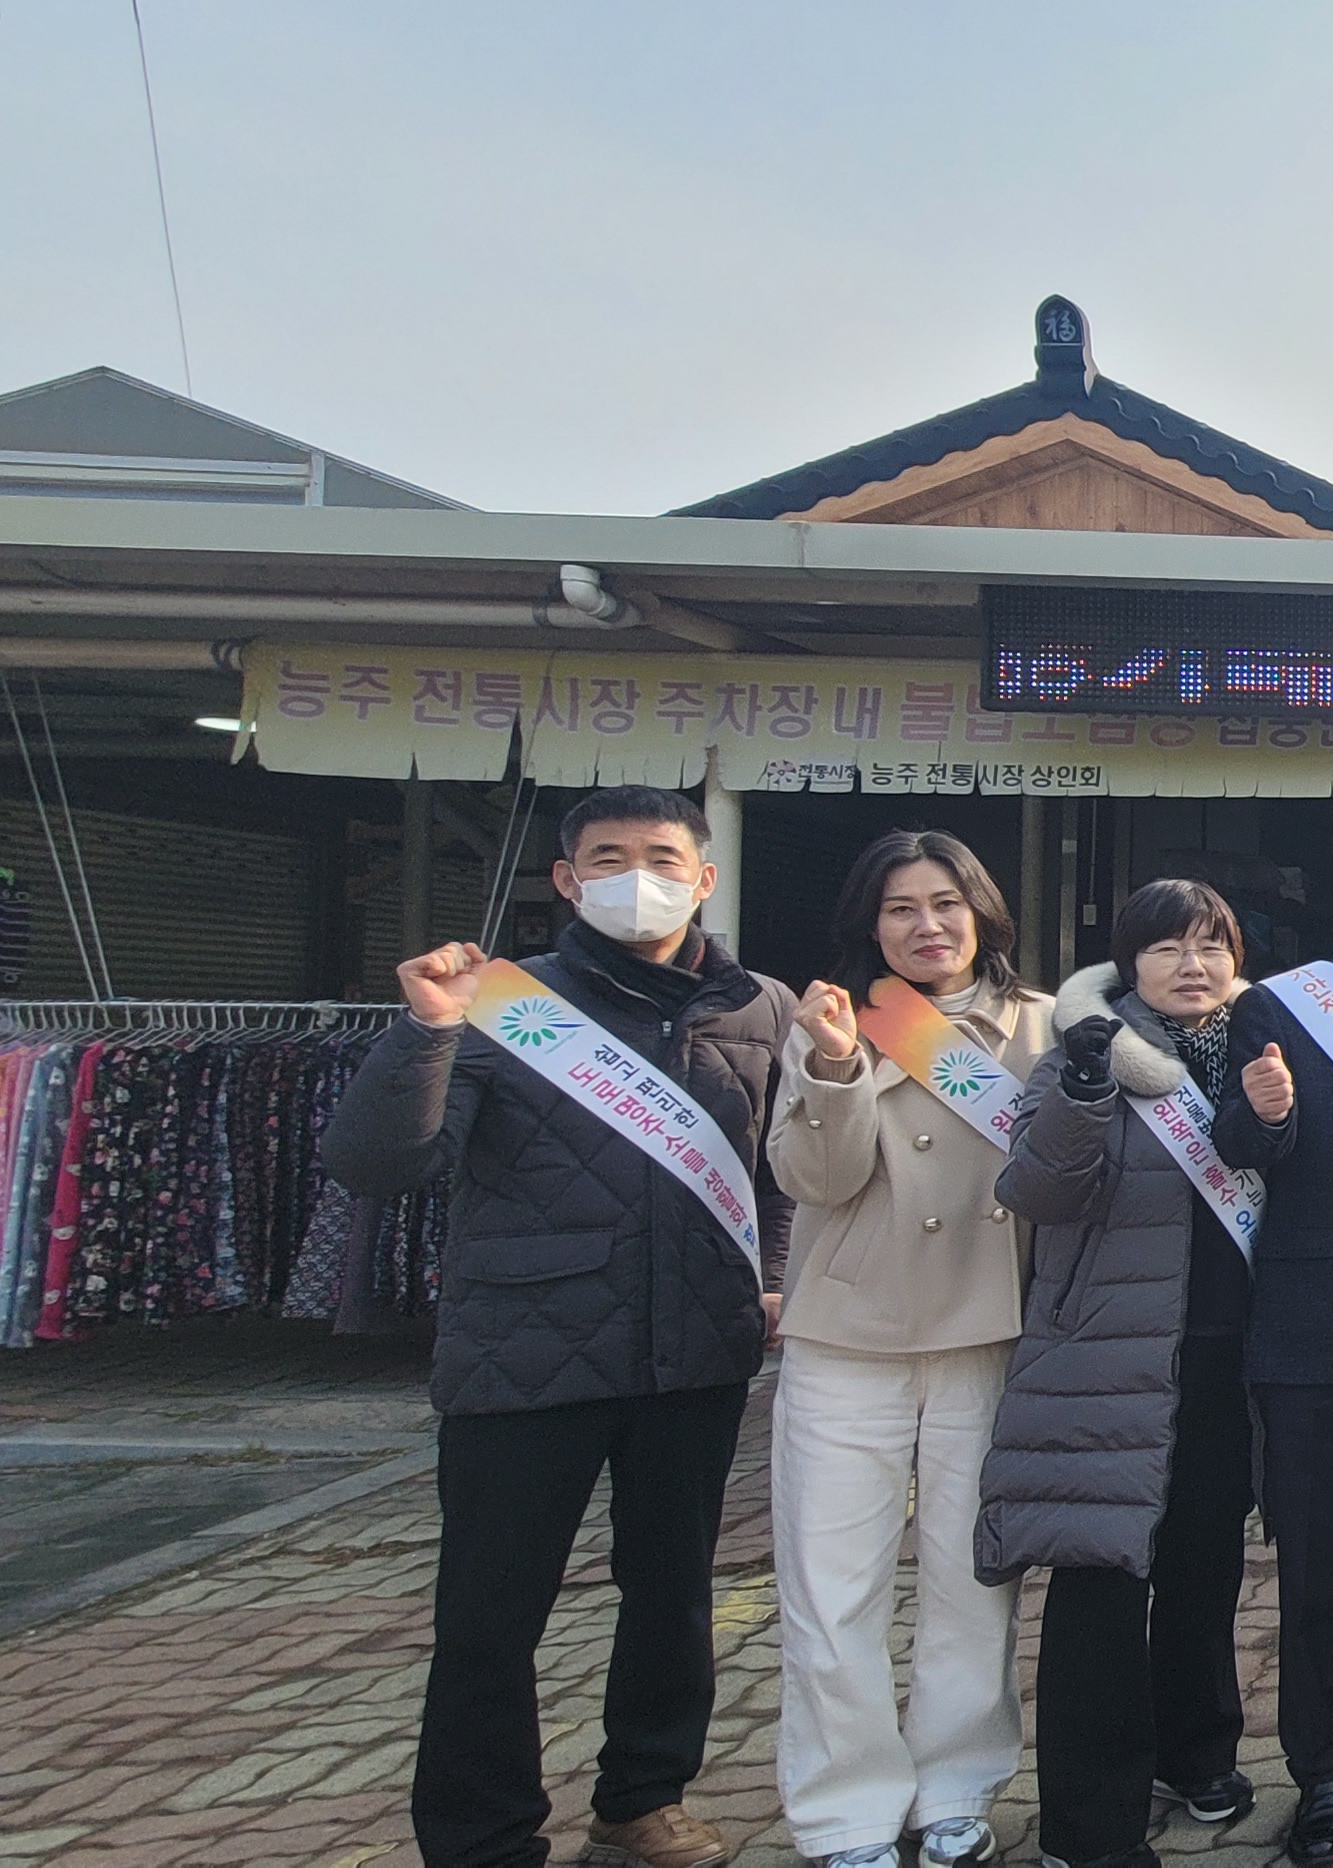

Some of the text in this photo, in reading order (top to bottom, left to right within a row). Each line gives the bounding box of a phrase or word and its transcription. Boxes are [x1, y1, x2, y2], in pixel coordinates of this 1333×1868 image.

[1045, 309, 1077, 342] 福
[277, 660, 392, 720] 능주
[411, 668, 642, 735] 전통시장
[655, 679, 820, 742] 주차장
[833, 686, 882, 742] 내
[870, 762, 920, 786] 능주
[925, 762, 1024, 787] 전통시장
[1030, 764, 1102, 789] 상인회
[594, 1043, 641, 1082] 쉽고
[634, 1076, 700, 1130] 편리한
[567, 1060, 749, 1228] 도로명주소를 생활화
[1152, 1097, 1210, 1166] 왼쪽은
[1201, 1163, 1241, 1209] 홀수
